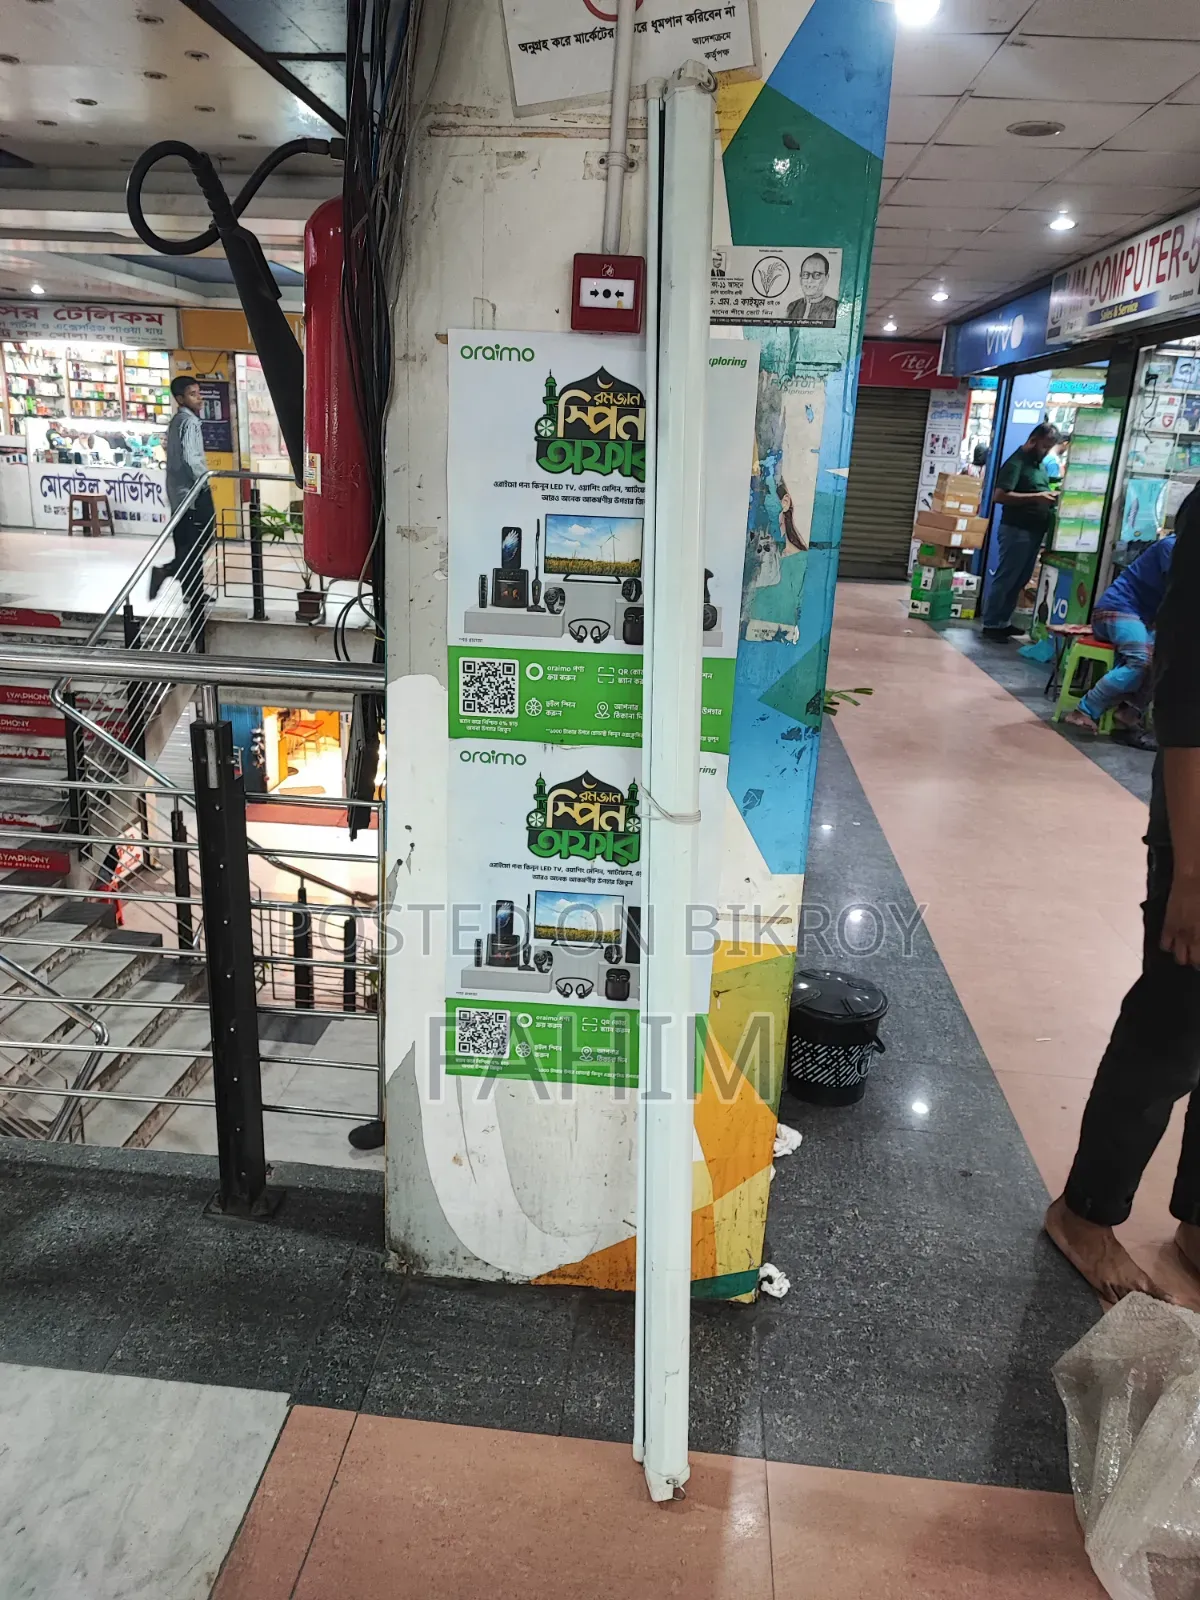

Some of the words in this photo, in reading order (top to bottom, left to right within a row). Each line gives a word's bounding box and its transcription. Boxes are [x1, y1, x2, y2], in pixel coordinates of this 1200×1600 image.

[518, 39, 550, 55] অনুগ্রহ
[552, 35, 571, 48] করে
[574, 27, 614, 45] মার্কেটের
[651, 17, 682, 35] ধূমপান
[686, 9, 721, 25] করিবেন
[725, 4, 736, 18] না
[53, 304, 165, 325] টেলিকম
[460, 344, 535, 363] oraimo
[901, 354, 935, 370] itel
[594, 391, 641, 407] রমজান
[1014, 399, 1044, 409] vivo
[565, 484, 576, 492] TV,
[618, 668, 628, 676] QR
[459, 750, 527, 766] oraimo
[579, 790, 622, 804] রমজান
[546, 788, 628, 832] স্পিন
[531, 830, 640, 866] অফার
